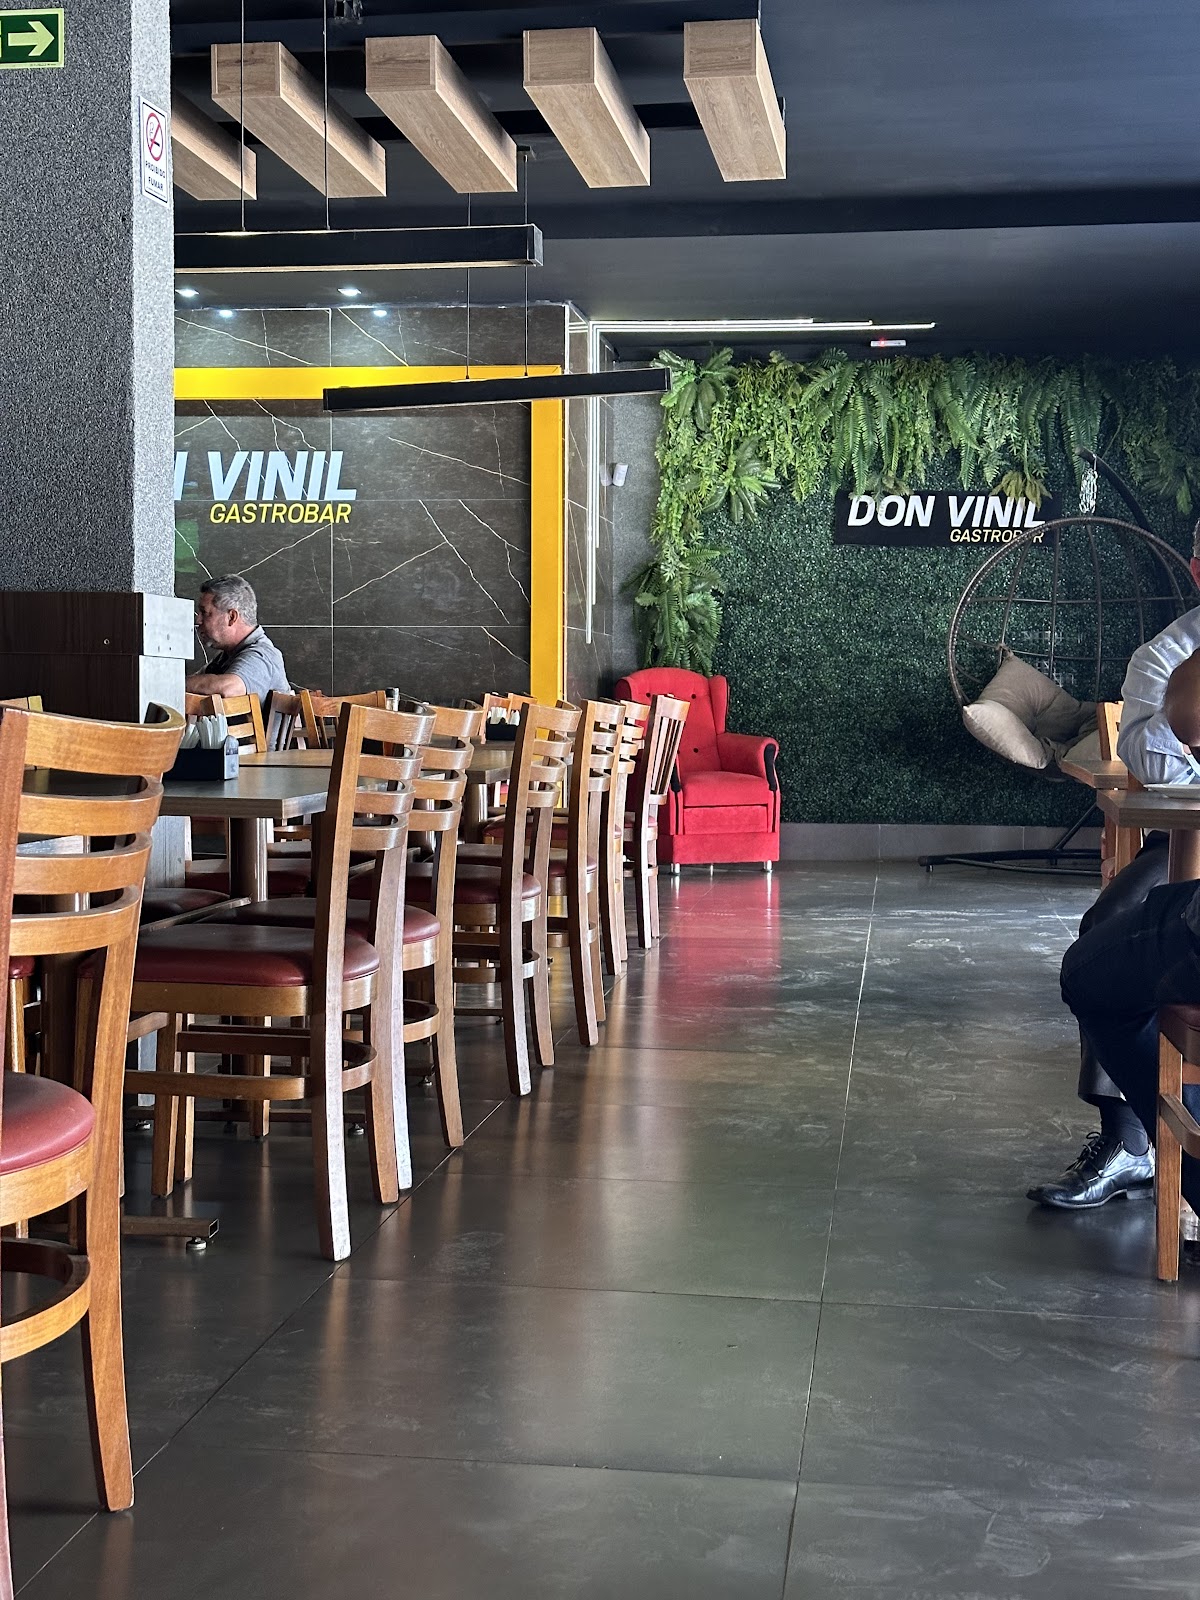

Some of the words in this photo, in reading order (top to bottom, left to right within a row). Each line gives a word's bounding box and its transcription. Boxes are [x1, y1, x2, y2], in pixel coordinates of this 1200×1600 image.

[208, 451, 357, 500] VINIL
[209, 503, 352, 524] GASTROBAR
[847, 495, 936, 527] DON
[948, 495, 1046, 528] VINIL
[950, 529, 1045, 543] GASTROR
